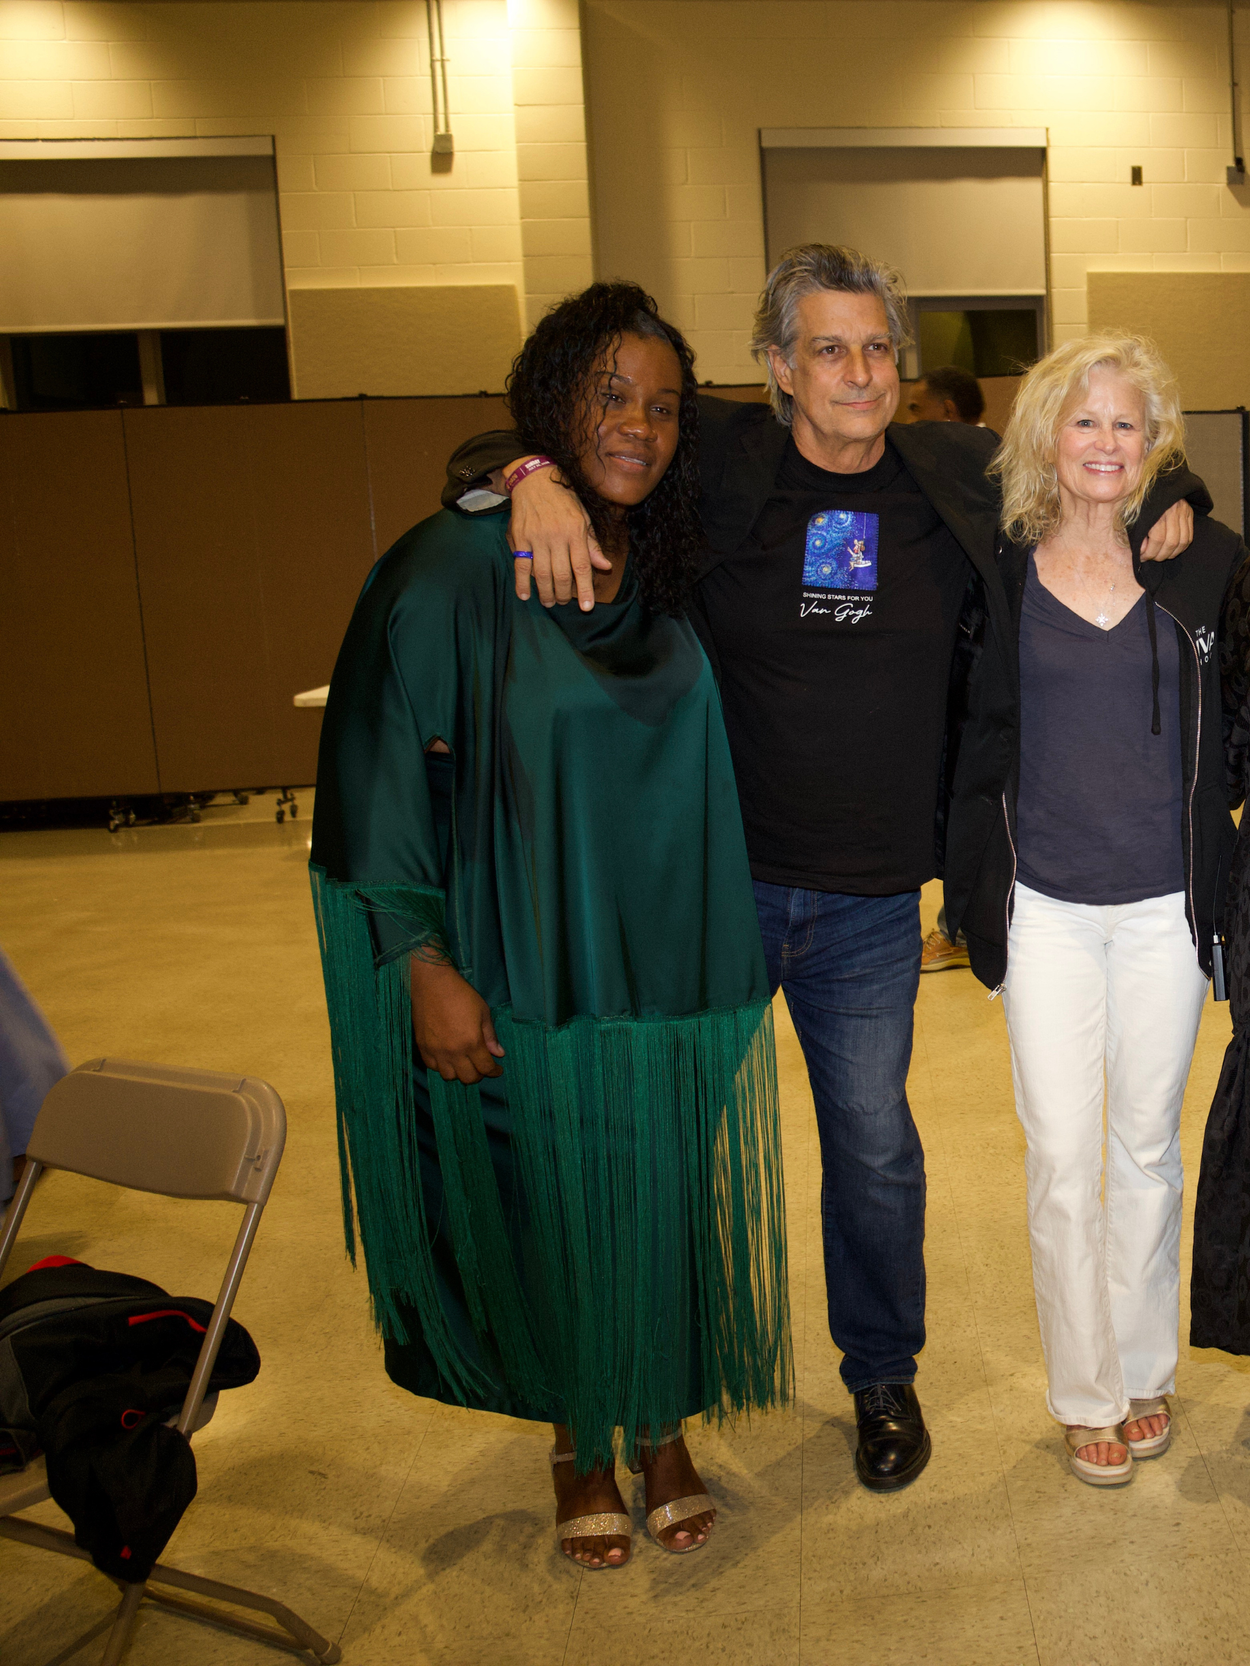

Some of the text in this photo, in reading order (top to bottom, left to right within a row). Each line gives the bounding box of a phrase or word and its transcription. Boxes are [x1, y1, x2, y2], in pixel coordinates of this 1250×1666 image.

[803, 592, 826, 600] SHINING
[800, 601, 873, 624] Van Gogh
[1195, 625, 1206, 637] THE
